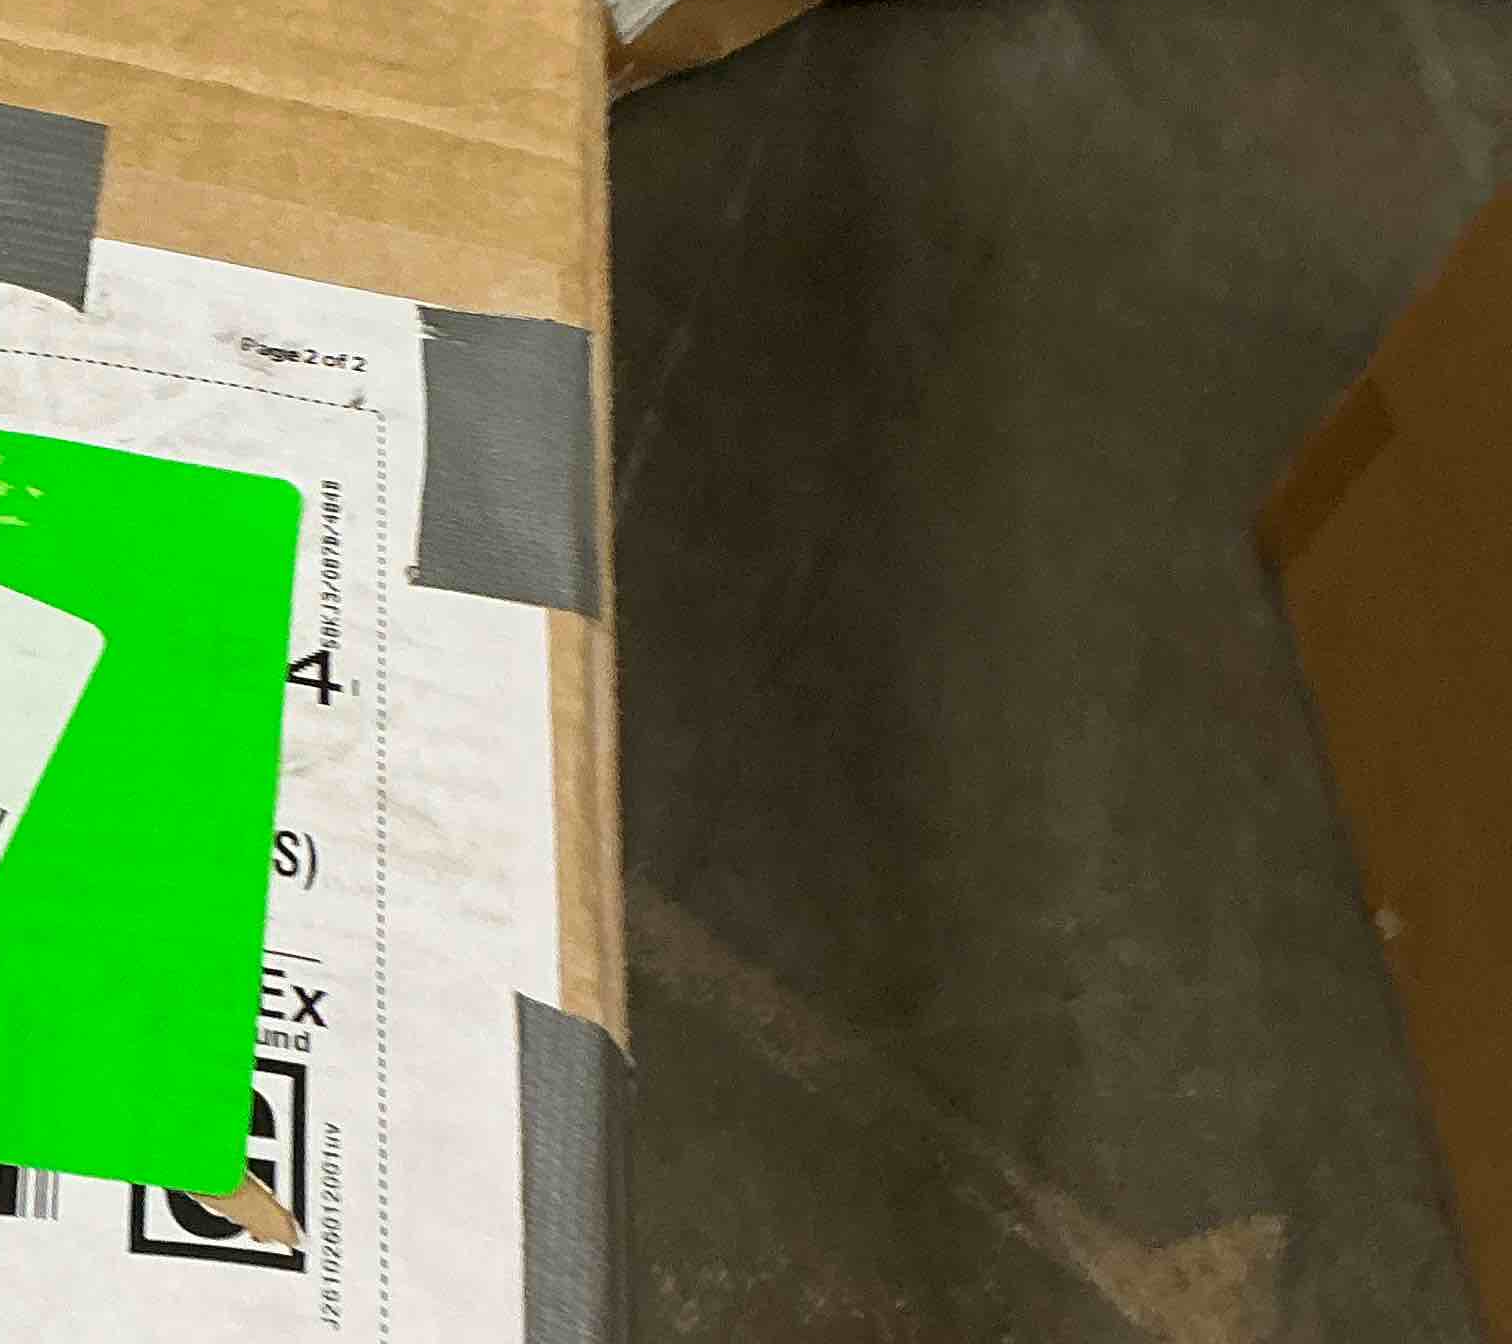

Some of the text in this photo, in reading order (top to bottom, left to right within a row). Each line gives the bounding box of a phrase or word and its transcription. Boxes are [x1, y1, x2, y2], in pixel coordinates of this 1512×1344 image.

[303, 348, 320, 365] 2
[322, 353, 349, 369] of
[351, 356, 368, 373] 2
